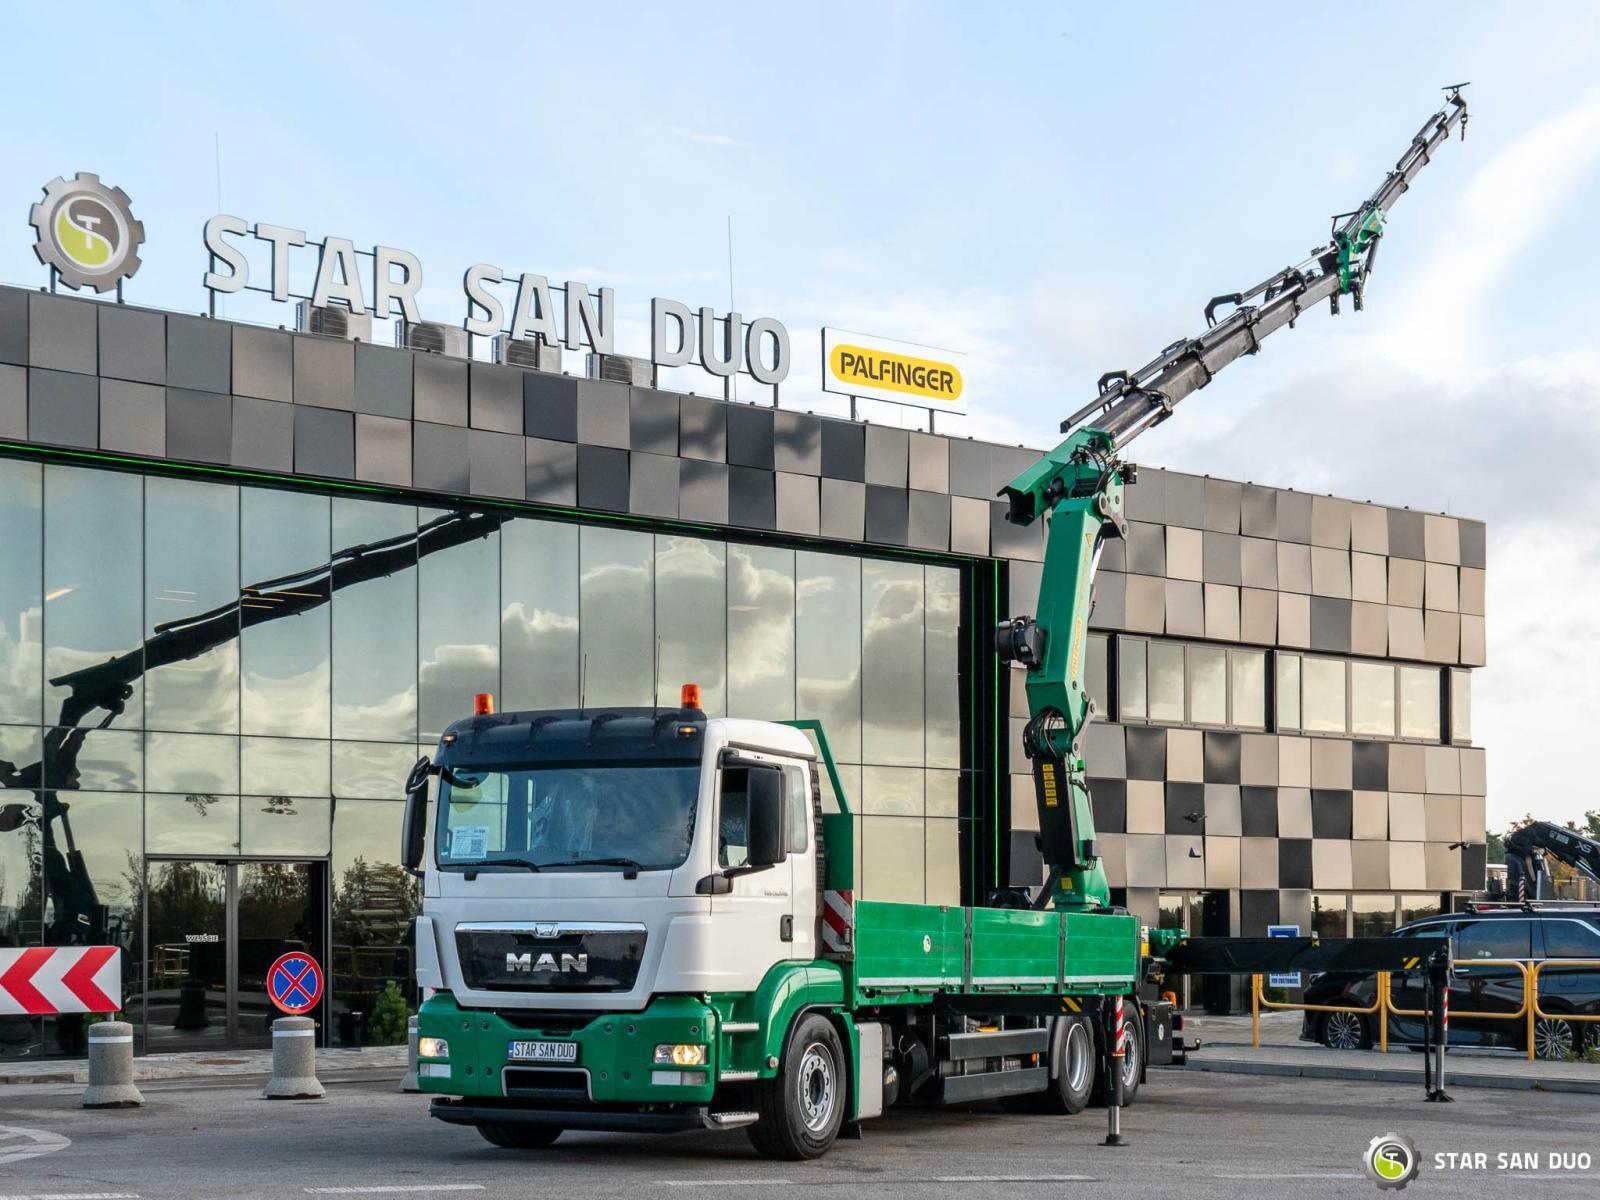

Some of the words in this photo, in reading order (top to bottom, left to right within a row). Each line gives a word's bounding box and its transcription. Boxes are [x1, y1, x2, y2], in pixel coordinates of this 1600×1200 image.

[203, 214, 423, 324] STAR
[463, 264, 615, 355] SAN
[651, 297, 791, 385] DUO
[840, 351, 954, 394] PALFINGER
[506, 953, 588, 972] MAN
[514, 1042, 537, 1057] STAR
[539, 1043, 555, 1057] SAN
[557, 1044, 575, 1058] DUO
